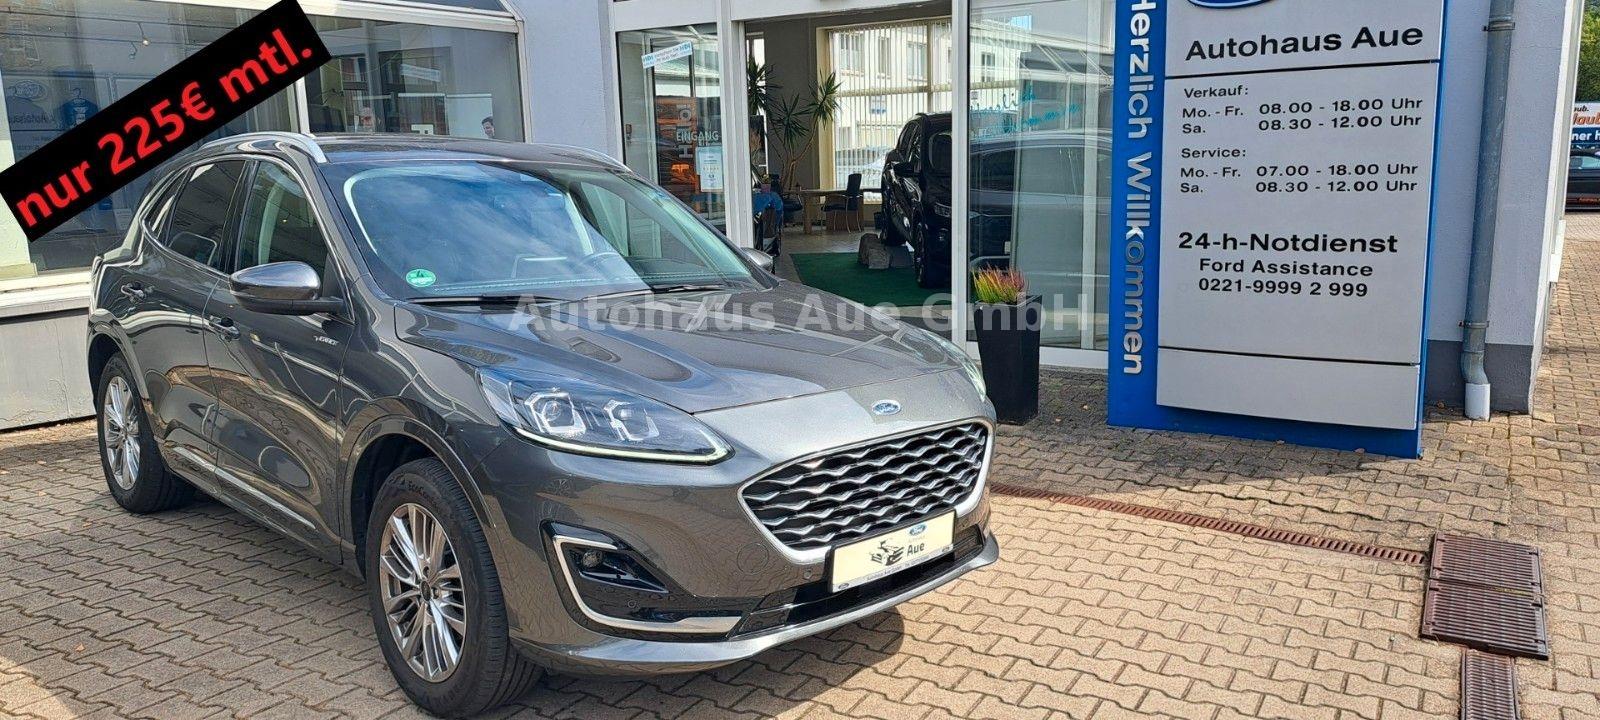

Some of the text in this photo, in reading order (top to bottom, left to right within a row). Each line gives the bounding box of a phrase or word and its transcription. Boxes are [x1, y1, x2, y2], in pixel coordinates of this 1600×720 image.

[1185, 26, 1424, 61] Autohaus Aue
[1184, 85, 1249, 99] Verkauf:
[1182, 107, 1212, 119] Mo.
[1224, 105, 1244, 117] Fr.
[1259, 101, 1312, 115] 08.00
[1333, 98, 1384, 112] 18.00
[1391, 97, 1423, 110] Uhr
[1182, 123, 1206, 134] Sa.
[1258, 118, 1312, 131] 08.30
[1331, 115, 1383, 128] 12.00
[1390, 114, 1422, 127] Uhr
[677, 130, 719, 142] EINGANG
[1181, 147, 1246, 159] Service:
[1180, 167, 1209, 179] Mo.
[1222, 166, 1241, 178] Fr.
[1256, 165, 1309, 177] 07.00
[1329, 164, 1379, 176] 18.00
[1387, 163, 1418, 175] Uhr
[1180, 182, 1204, 193] Sa.
[1255, 180, 1308, 193] 08.30
[1327, 180, 1378, 192] 12.00
[1386, 180, 1418, 192] Uhr
[1178, 231, 1398, 252] 24-h-Notdienst
[1123, 151, 1152, 375] Willkommen
[1199, 258, 1373, 276] Ford Assistance
[1198, 278, 1368, 297] 0221-9999 2 999
[907, 543, 925, 557] Aue
